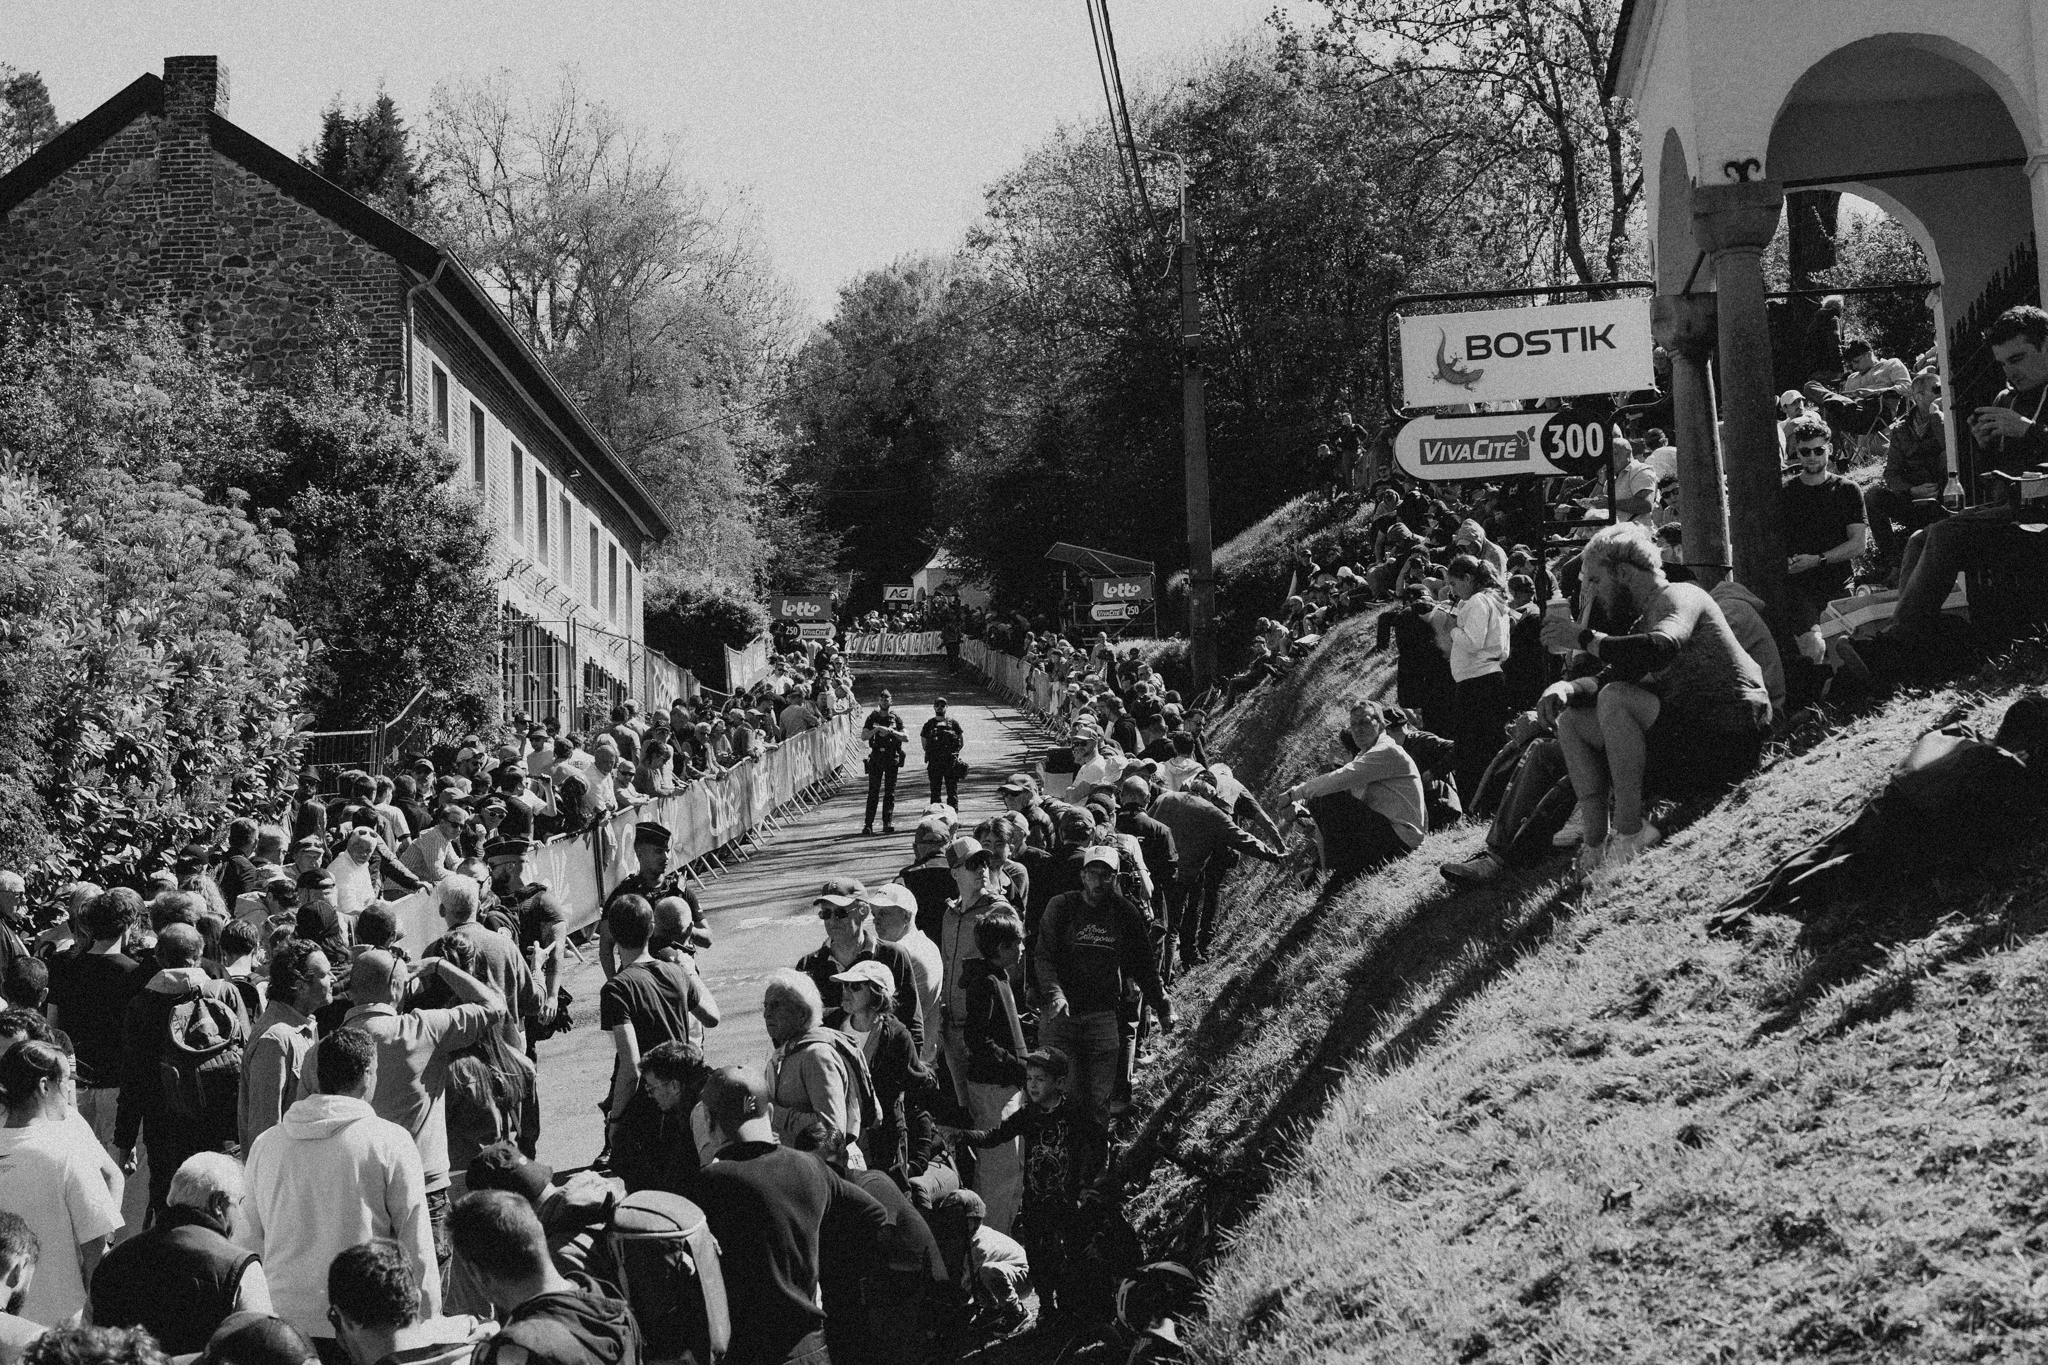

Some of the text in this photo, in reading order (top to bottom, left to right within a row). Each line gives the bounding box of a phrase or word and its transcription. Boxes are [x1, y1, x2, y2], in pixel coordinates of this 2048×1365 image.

[1465, 323, 1617, 361] BOSTIK
[1549, 422, 1604, 460] 300
[889, 588, 908, 598] AG
[1127, 605, 1140, 615] 250
[785, 625, 798, 635] 250
